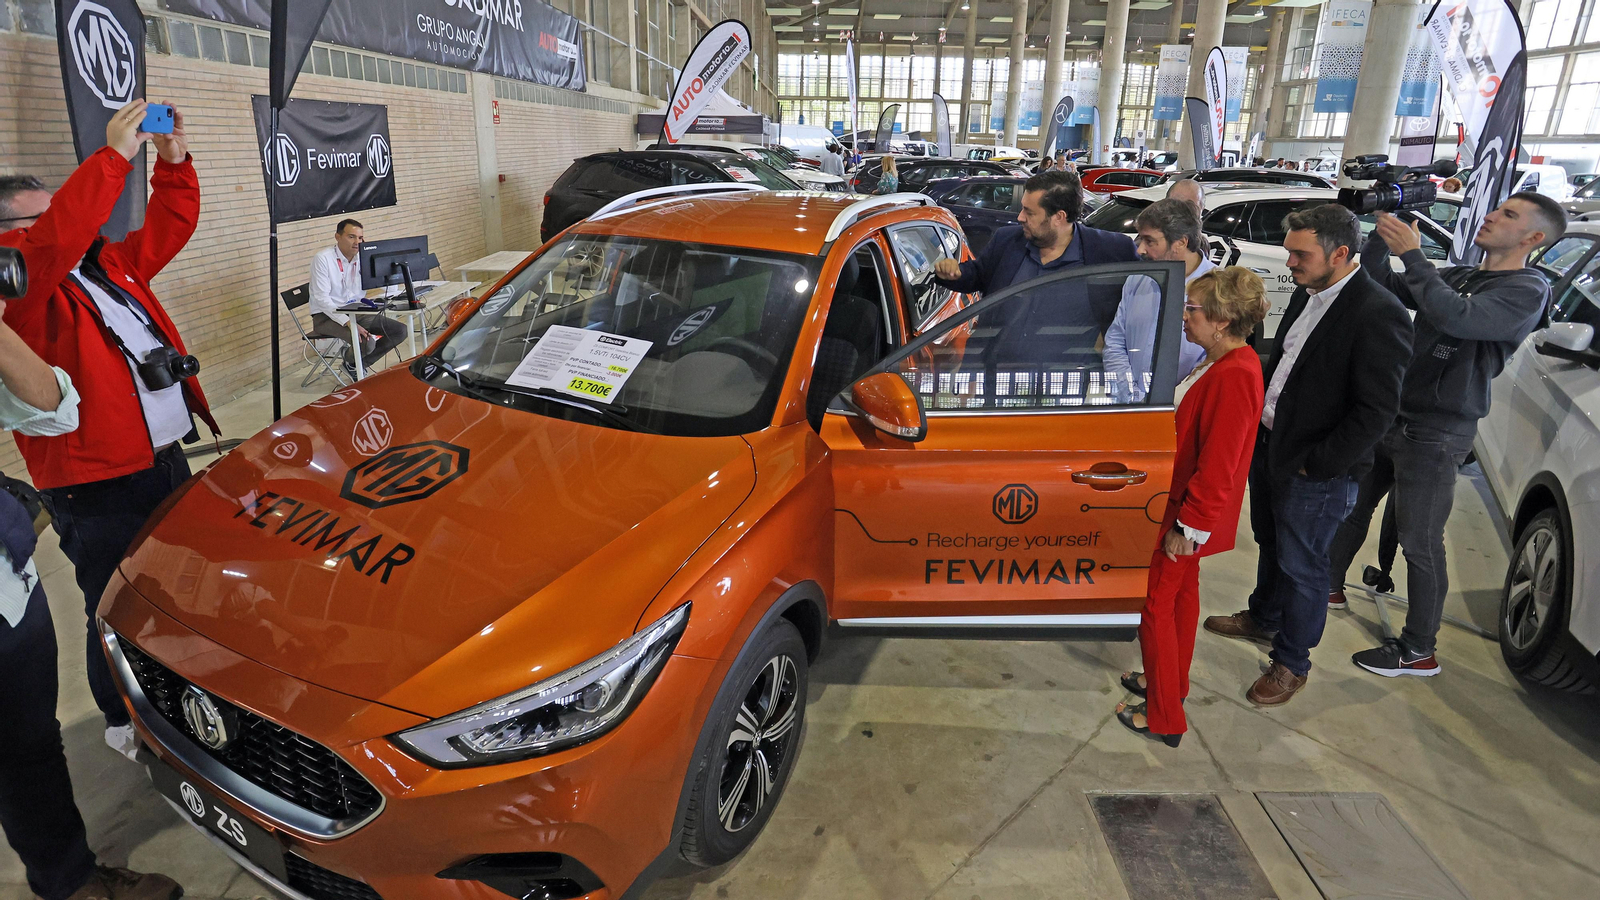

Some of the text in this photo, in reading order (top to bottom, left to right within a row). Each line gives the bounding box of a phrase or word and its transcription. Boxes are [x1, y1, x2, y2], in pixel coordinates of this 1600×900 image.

[417, 14, 454, 40] GRUPO
[444, 0, 524, 32] DIMAR
[1332, 9, 1366, 19] IFECA
[76, 12, 134, 100] MG
[538, 31, 558, 53] AUTO
[671, 45, 731, 121] AUTO motor10
[708, 44, 749, 94] CADIMAR-FEVIMAR
[306, 148, 361, 169] Fevimar
[367, 136, 389, 176] MG
[1402, 136, 1432, 145] NIMAUTO
[609, 352, 632, 362] 104CV
[570, 379, 612, 396] 13.700€
[356, 446, 459, 501] MG
[996, 487, 1035, 521] MG
[233, 491, 415, 585] FEVIMAR
[927, 531, 1102, 551] Recharge yourself
[925, 558, 1096, 585] FEVIMAR
[181, 783, 248, 847] MG ZS
